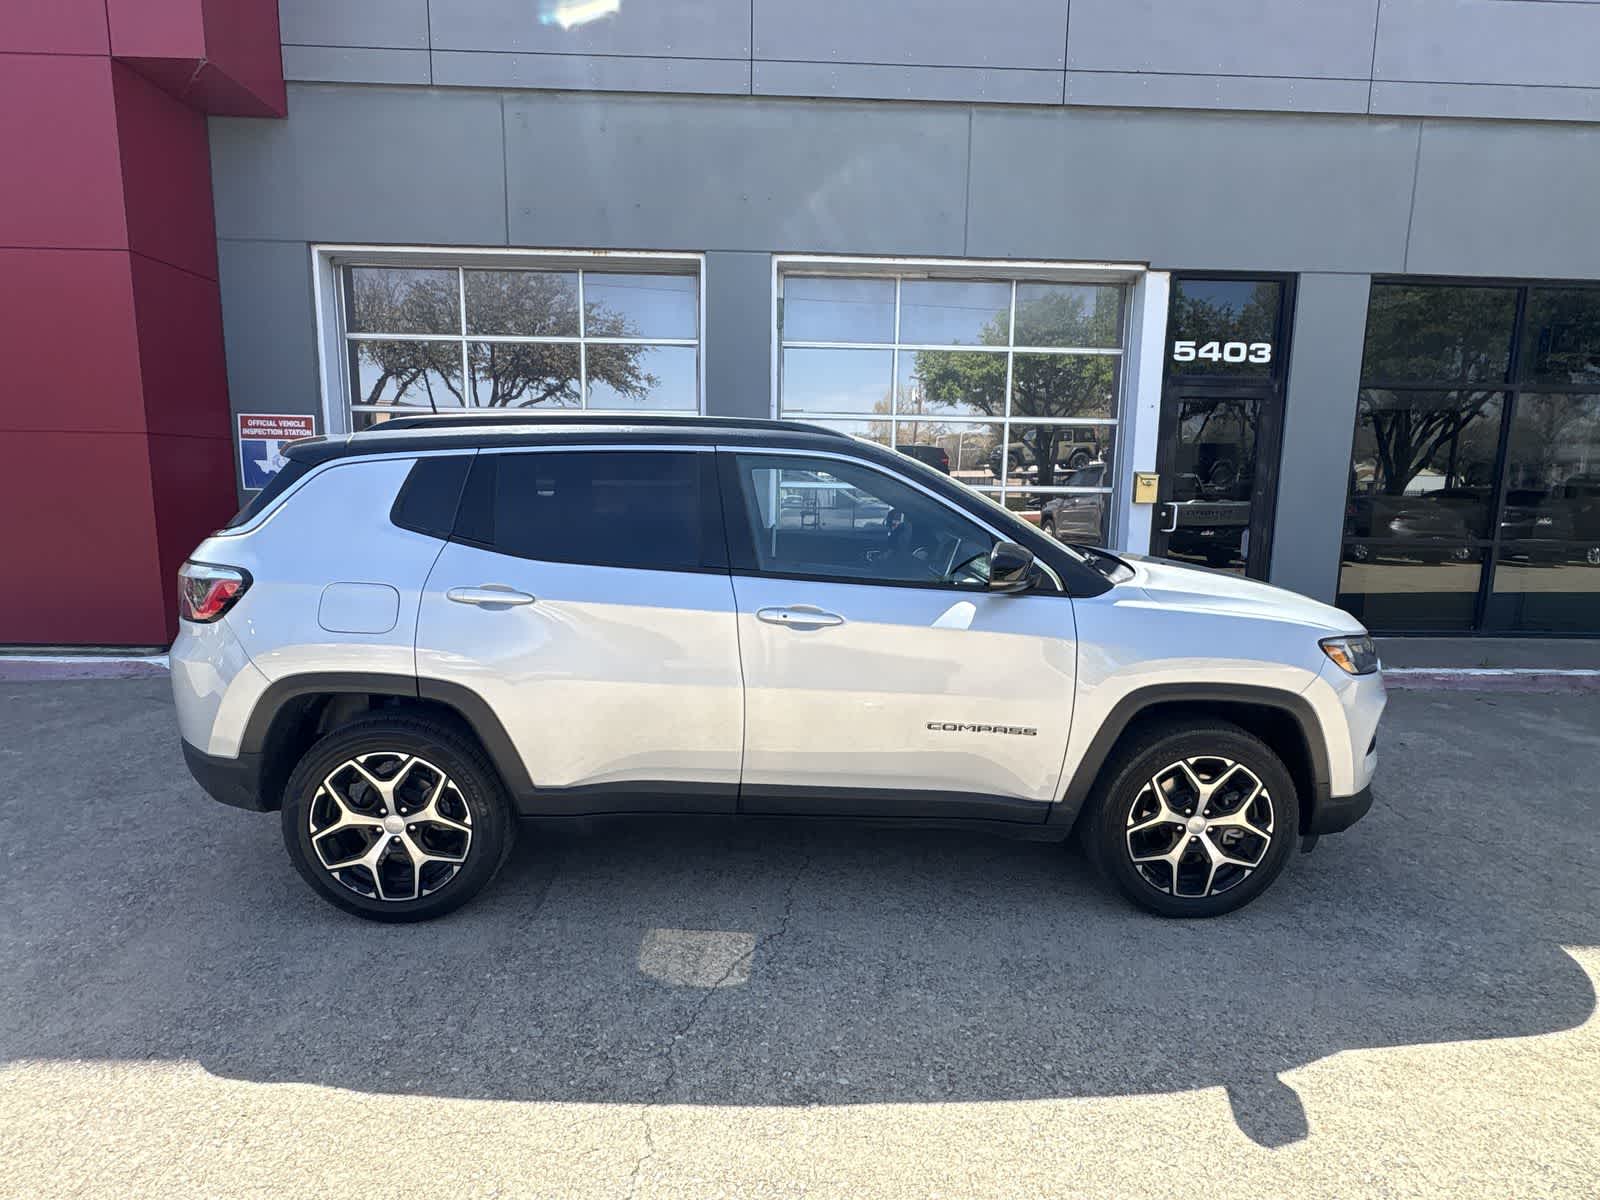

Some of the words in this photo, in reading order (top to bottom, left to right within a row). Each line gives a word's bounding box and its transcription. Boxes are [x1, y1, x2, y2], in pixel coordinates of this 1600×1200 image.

[1173, 341, 1271, 363] 5403
[247, 419, 277, 427] OFFICIAL
[284, 428, 312, 436] STATION
[927, 722, 1037, 736] COMPASS
